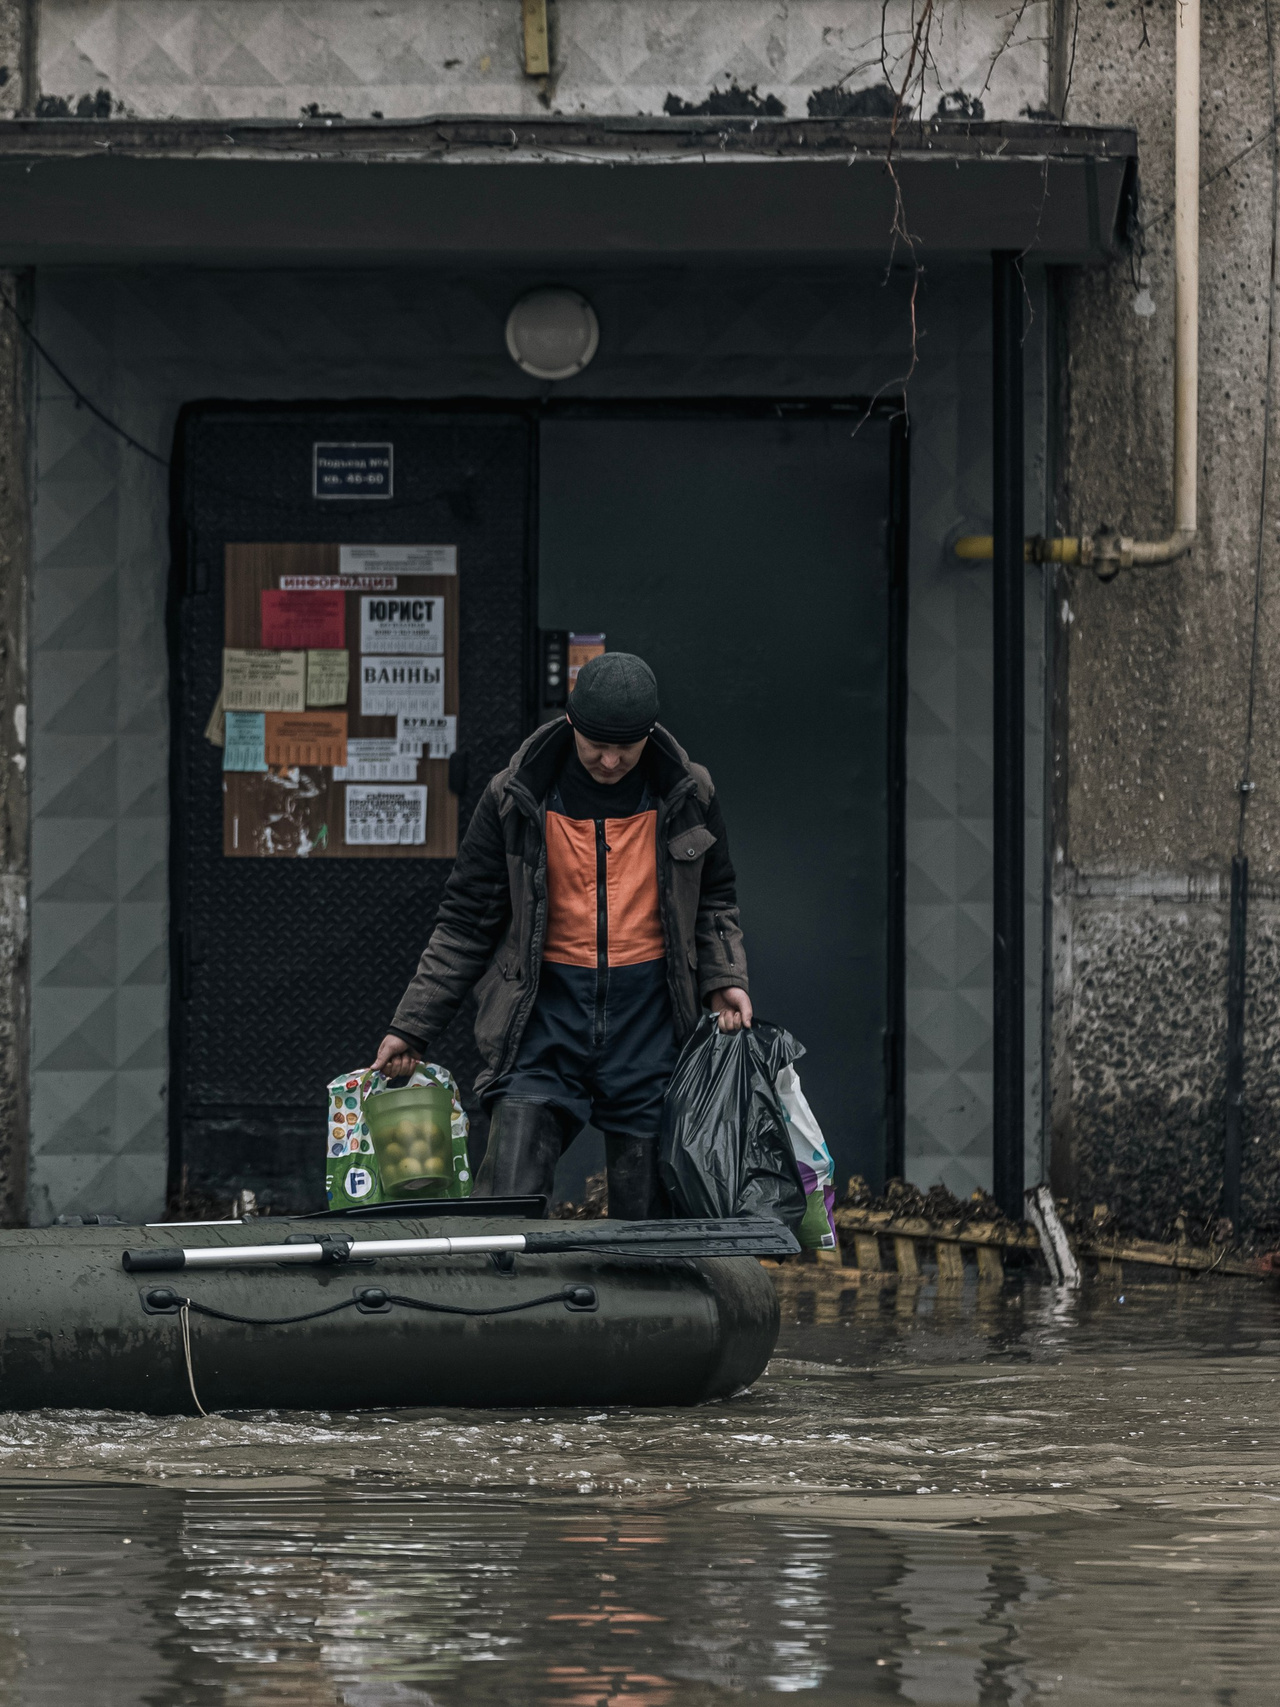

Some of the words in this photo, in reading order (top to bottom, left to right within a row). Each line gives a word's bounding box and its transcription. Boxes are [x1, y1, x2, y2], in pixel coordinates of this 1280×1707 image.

[284, 577, 395, 589] ИНФОРМАЦИЯ
[369, 600, 435, 622] ЮРИСТ
[364, 667, 440, 683] ВАННЫ
[403, 718, 448, 727] КУПЛЮ
[350, 1172, 365, 1194] F
